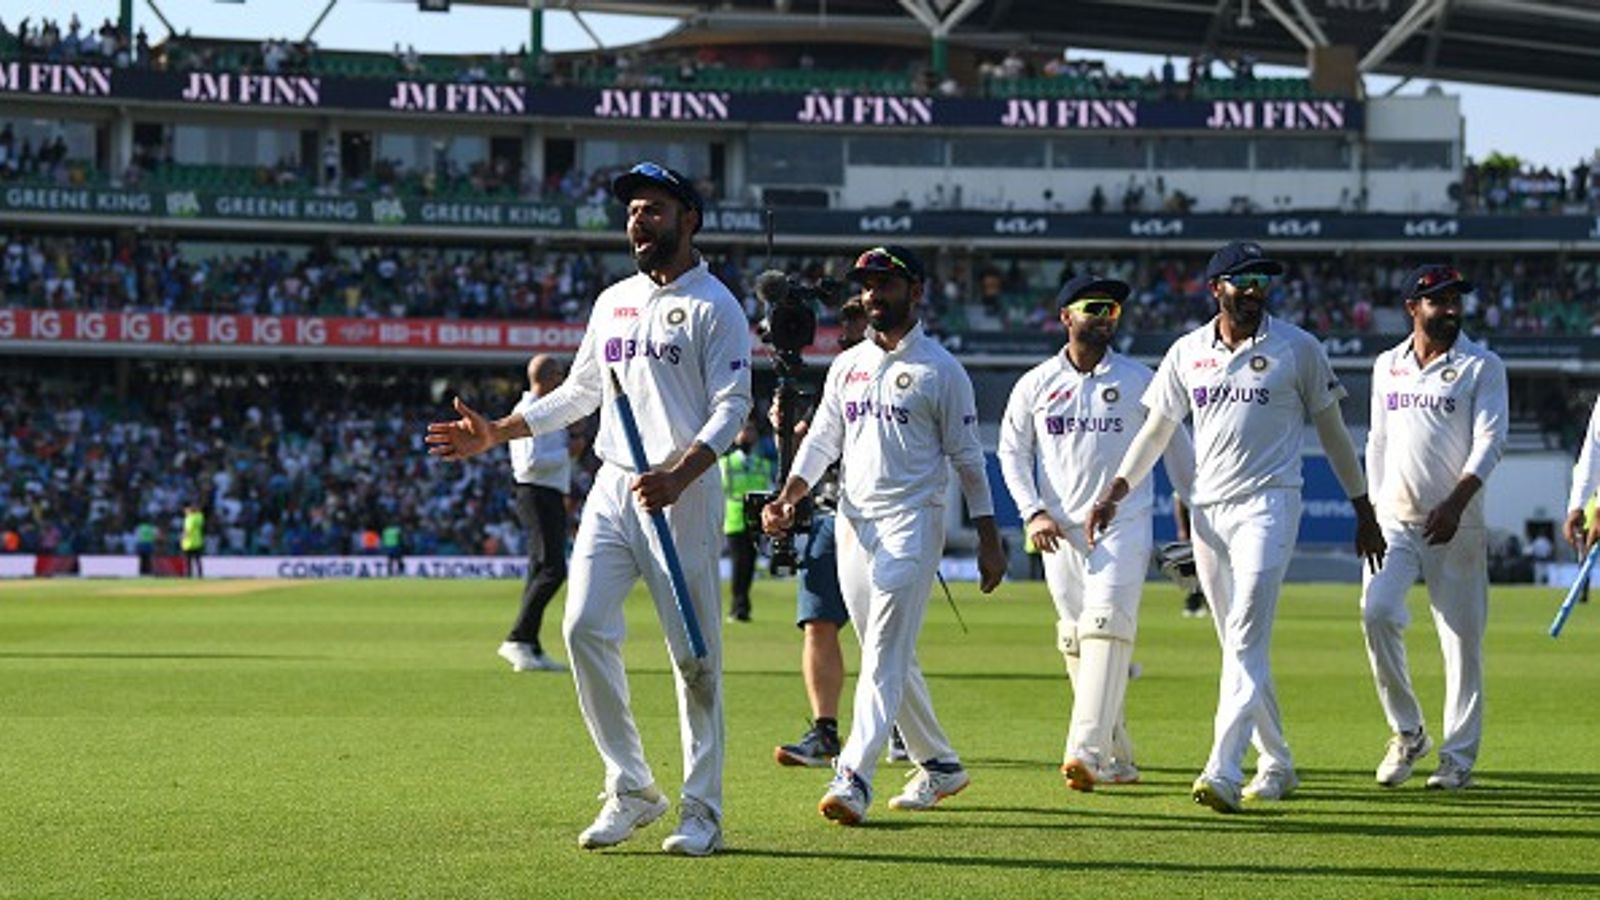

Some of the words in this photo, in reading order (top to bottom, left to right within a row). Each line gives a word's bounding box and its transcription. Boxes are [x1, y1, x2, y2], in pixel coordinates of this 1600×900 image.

[29, 64, 111, 94] FINN
[182, 73, 229, 100] JM
[239, 75, 320, 106] FINN
[390, 82, 436, 111] JM
[445, 84, 525, 113] FINN
[595, 89, 640, 117] JM
[650, 91, 730, 119] FINN
[797, 95, 843, 122] JM
[852, 96, 932, 123] FINN
[1001, 99, 1048, 127] JM
[1056, 100, 1137, 127] FINN
[1206, 102, 1253, 128] JM
[1262, 102, 1344, 129] FINN
[6, 188, 90, 209] GREENE
[97, 193, 151, 211] KING
[215, 196, 298, 217] GREENE
[304, 199, 358, 218] KING
[421, 203, 501, 223] GREENE
[508, 205, 561, 224] KING
[31, 310, 61, 338] IG
[76, 312, 106, 339] IG
[120, 313, 150, 340] IG
[164, 313, 194, 341] IG
[208, 315, 237, 342] IG
[252, 317, 282, 343] IG
[296, 318, 327, 344] IG
[624, 339, 682, 365] BJU'S
[1400, 393, 1455, 413] BYJU'S
[277, 561, 496, 579] CONGRATATIONS
